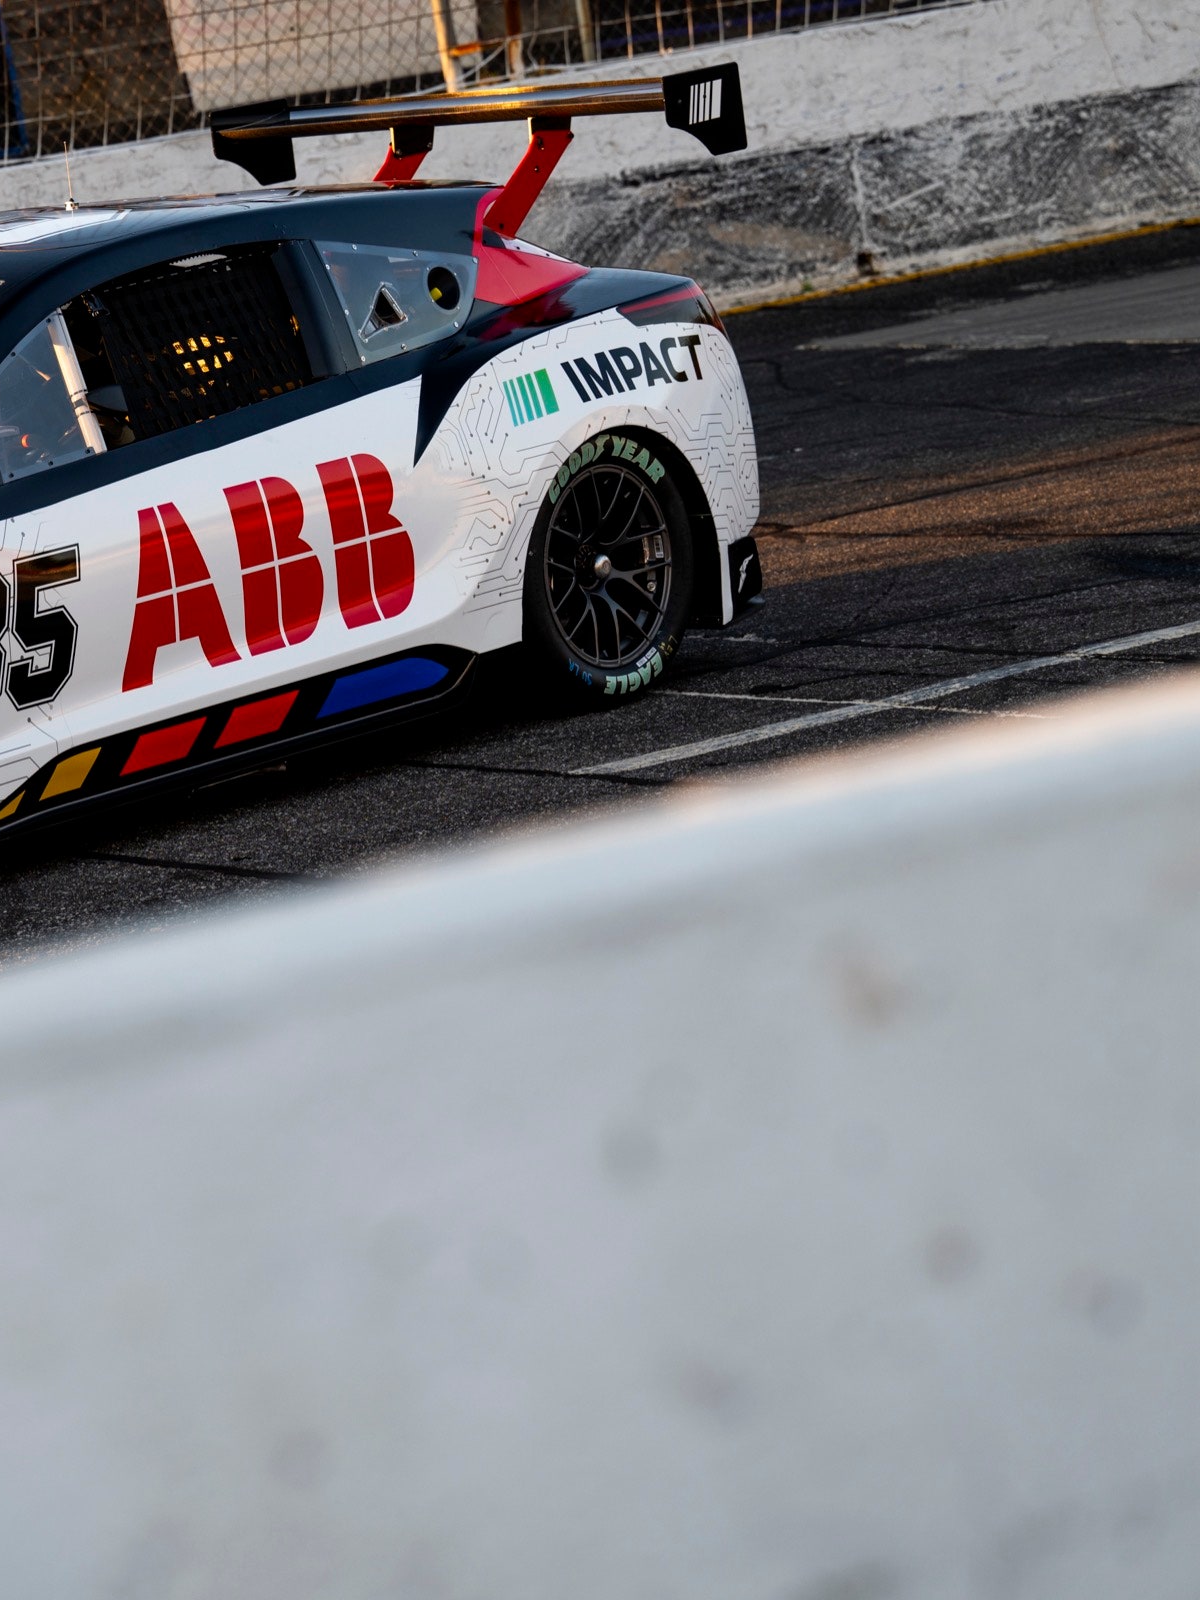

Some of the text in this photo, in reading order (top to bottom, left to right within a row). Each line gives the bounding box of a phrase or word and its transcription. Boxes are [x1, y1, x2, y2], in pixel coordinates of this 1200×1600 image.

[560, 334, 704, 404] IMPACT
[548, 434, 666, 505] GOODYEAR
[121, 452, 416, 693] ABB
[603, 651, 663, 695] EAGLE
